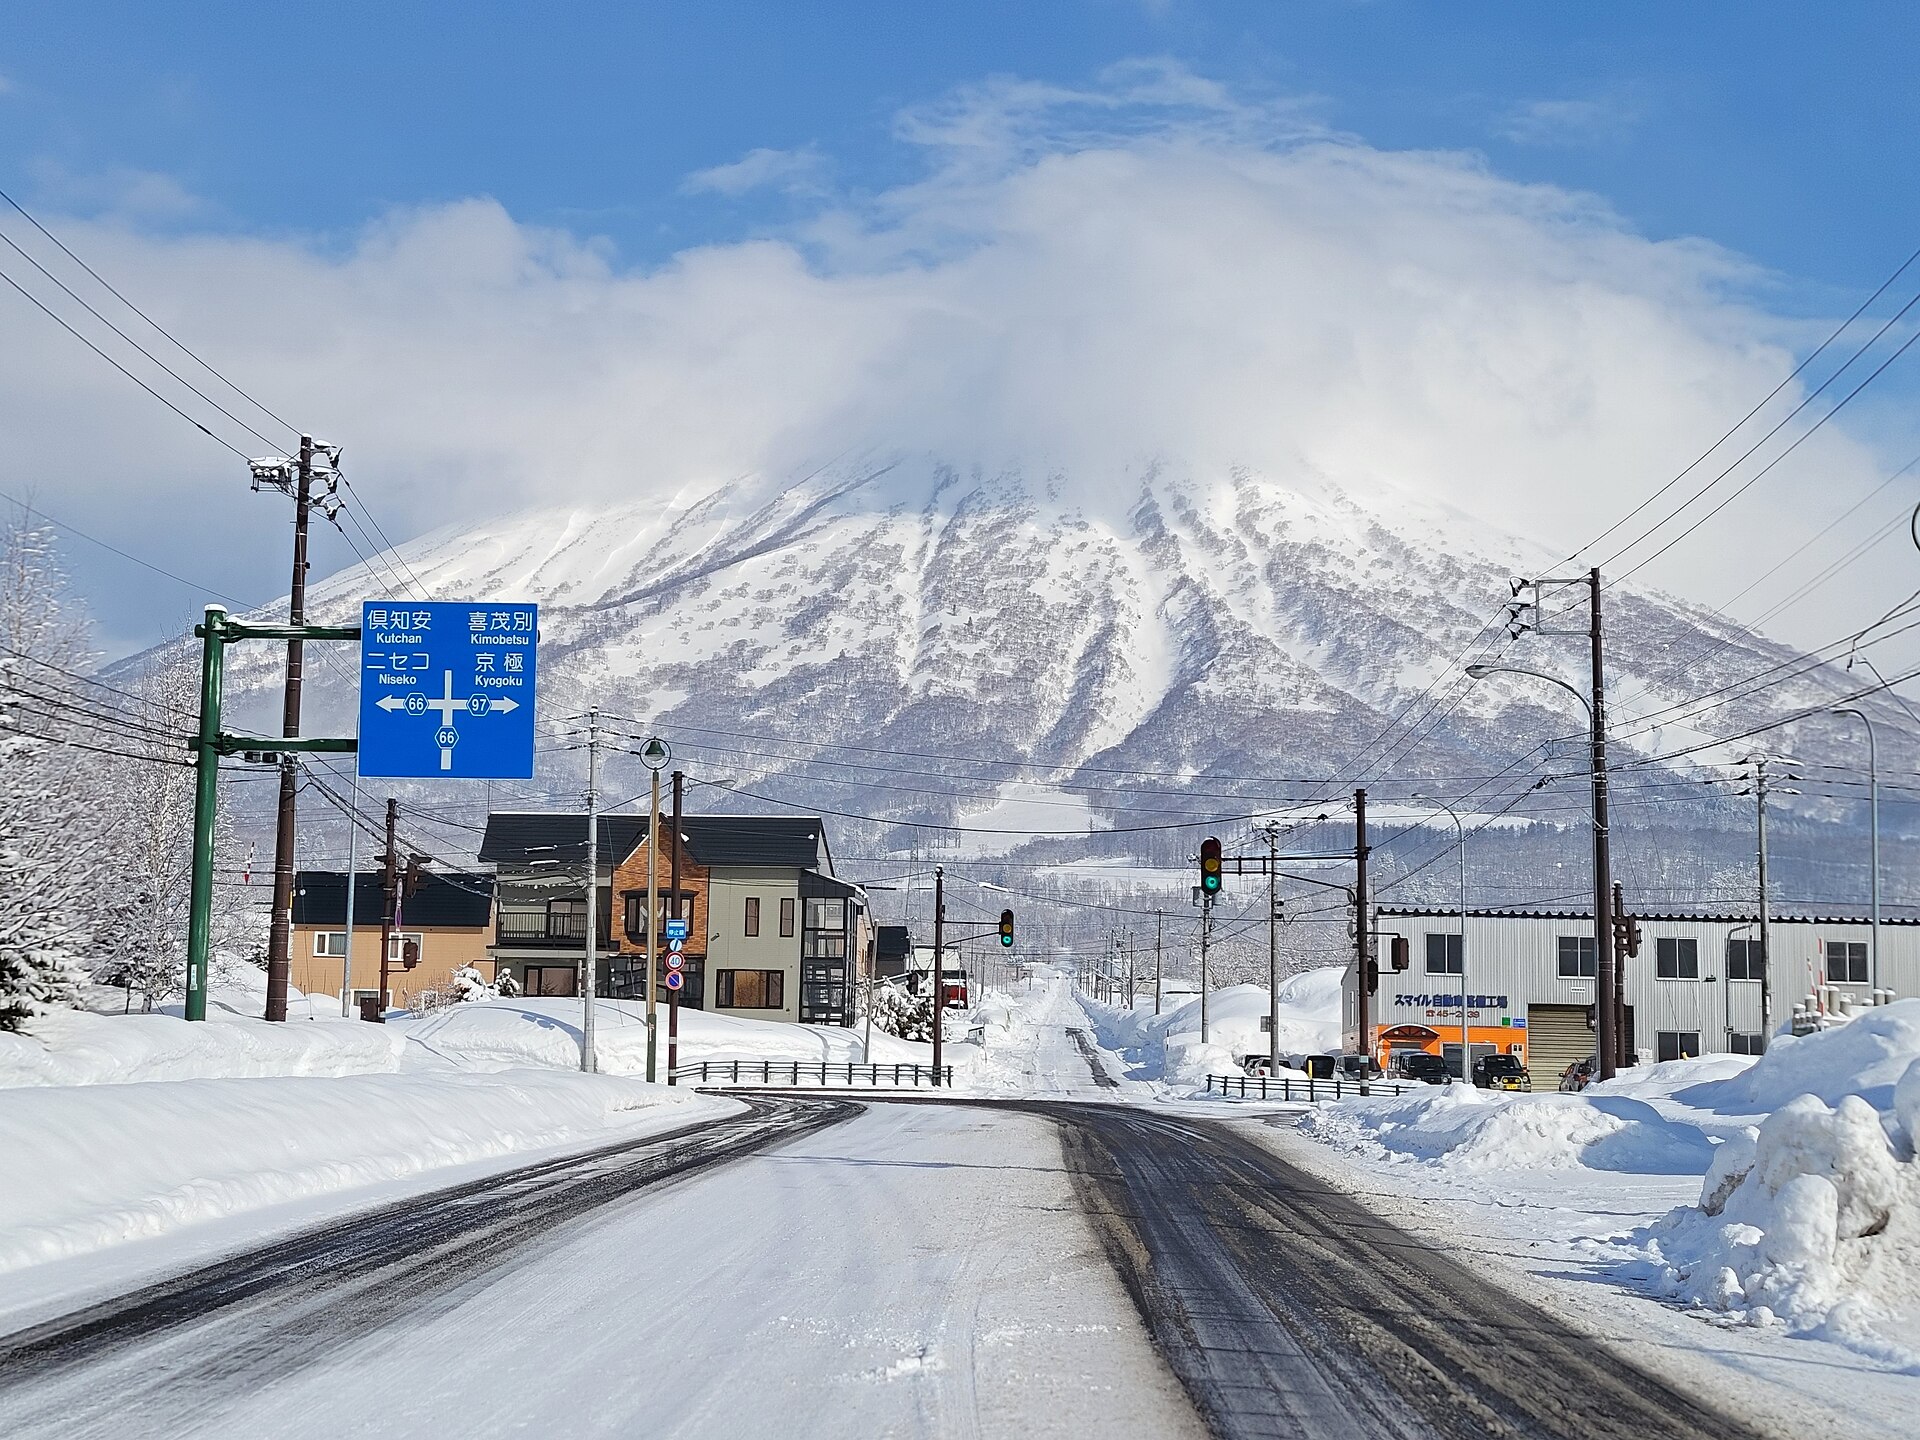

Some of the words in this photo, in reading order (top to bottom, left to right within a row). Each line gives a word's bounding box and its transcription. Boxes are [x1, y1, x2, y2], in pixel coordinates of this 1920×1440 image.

[468, 611, 533, 631] 喜茂別
[376, 633, 422, 644] Kutchan
[470, 634, 529, 645] Kimobetsu
[366, 652, 430, 671] ニセコ
[379, 674, 417, 685] Niseko
[475, 675, 523, 687] Kyogoku
[408, 698, 424, 711] 66
[471, 699, 487, 712] 97
[439, 731, 455, 744] 66
[670, 957, 680, 965] 40
[1436, 1010, 1480, 1018] 45-239
